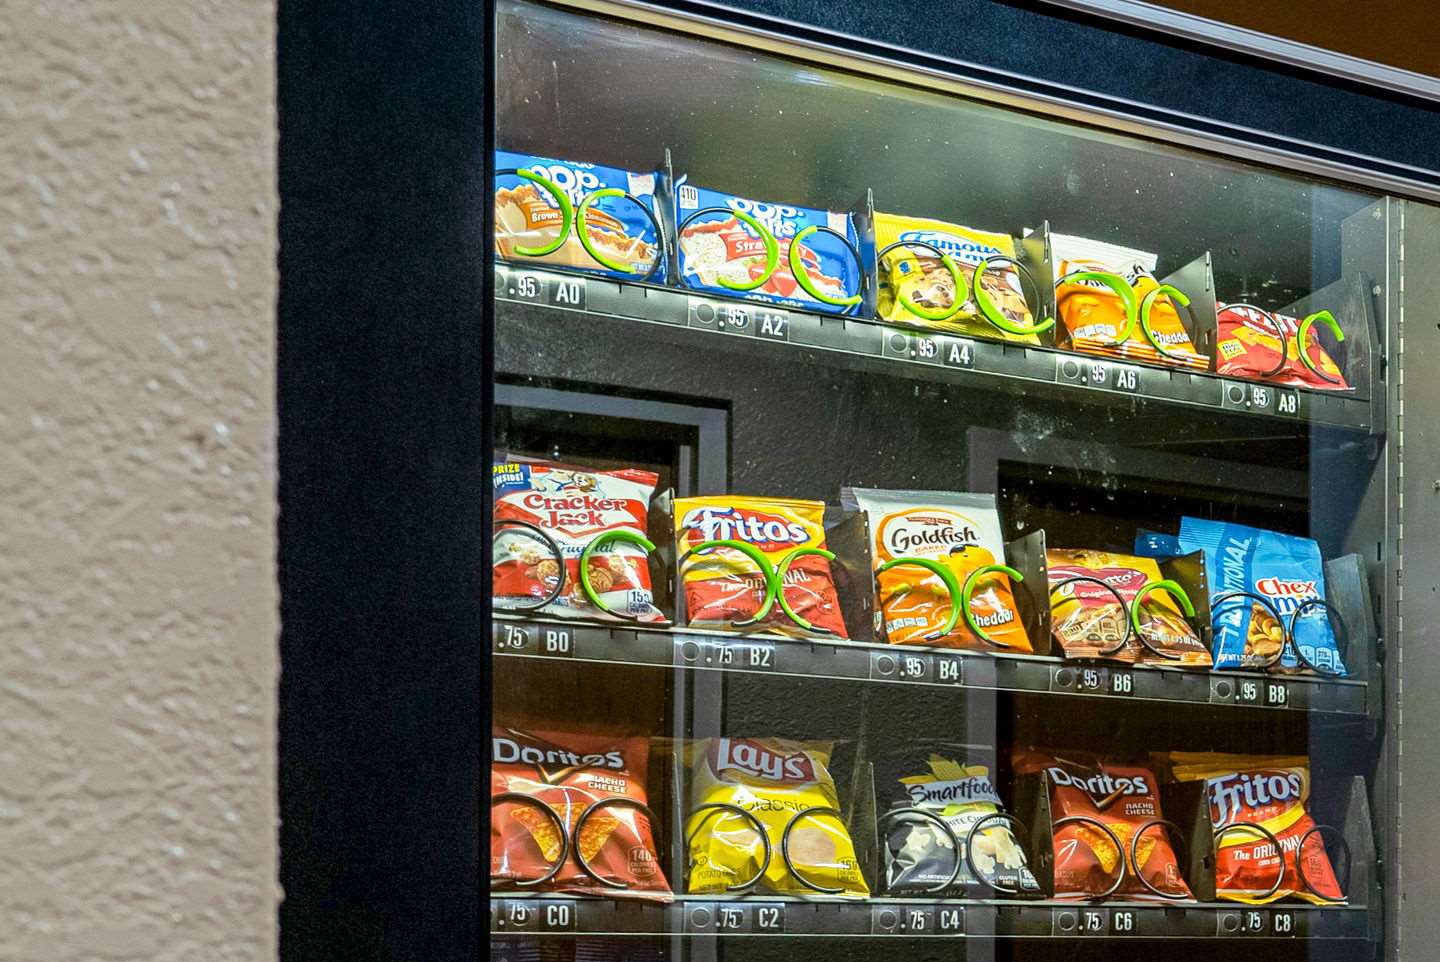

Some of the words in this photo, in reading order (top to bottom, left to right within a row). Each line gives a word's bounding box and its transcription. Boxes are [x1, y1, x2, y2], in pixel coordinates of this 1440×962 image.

[556, 283, 580, 304] A0
[761, 317, 784, 336] A2
[949, 343, 970, 364] A4
[1117, 370, 1136, 389] A6
[1278, 393, 1297, 413] A8
[523, 493, 627, 511] Cracker
[541, 511, 605, 528] Jack
[682, 506, 811, 549] Fritos
[891, 526, 977, 553] Goldfish
[1256, 577, 1318, 596] Chex
[546, 631, 569, 652] B0
[750, 648, 770, 667] B2
[939, 661, 959, 680] B4
[1113, 674, 1131, 692] B6
[1268, 686, 1286, 703] B8
[492, 738, 624, 769] Doritos
[1048, 767, 1149, 795] Doritos
[1208, 773, 1300, 828] Fritos
[547, 905, 569, 926] C0
[758, 908, 779, 928] C2
[940, 910, 960, 929] C4
[1115, 912, 1132, 931] C6
[1275, 914, 1291, 932] C8
